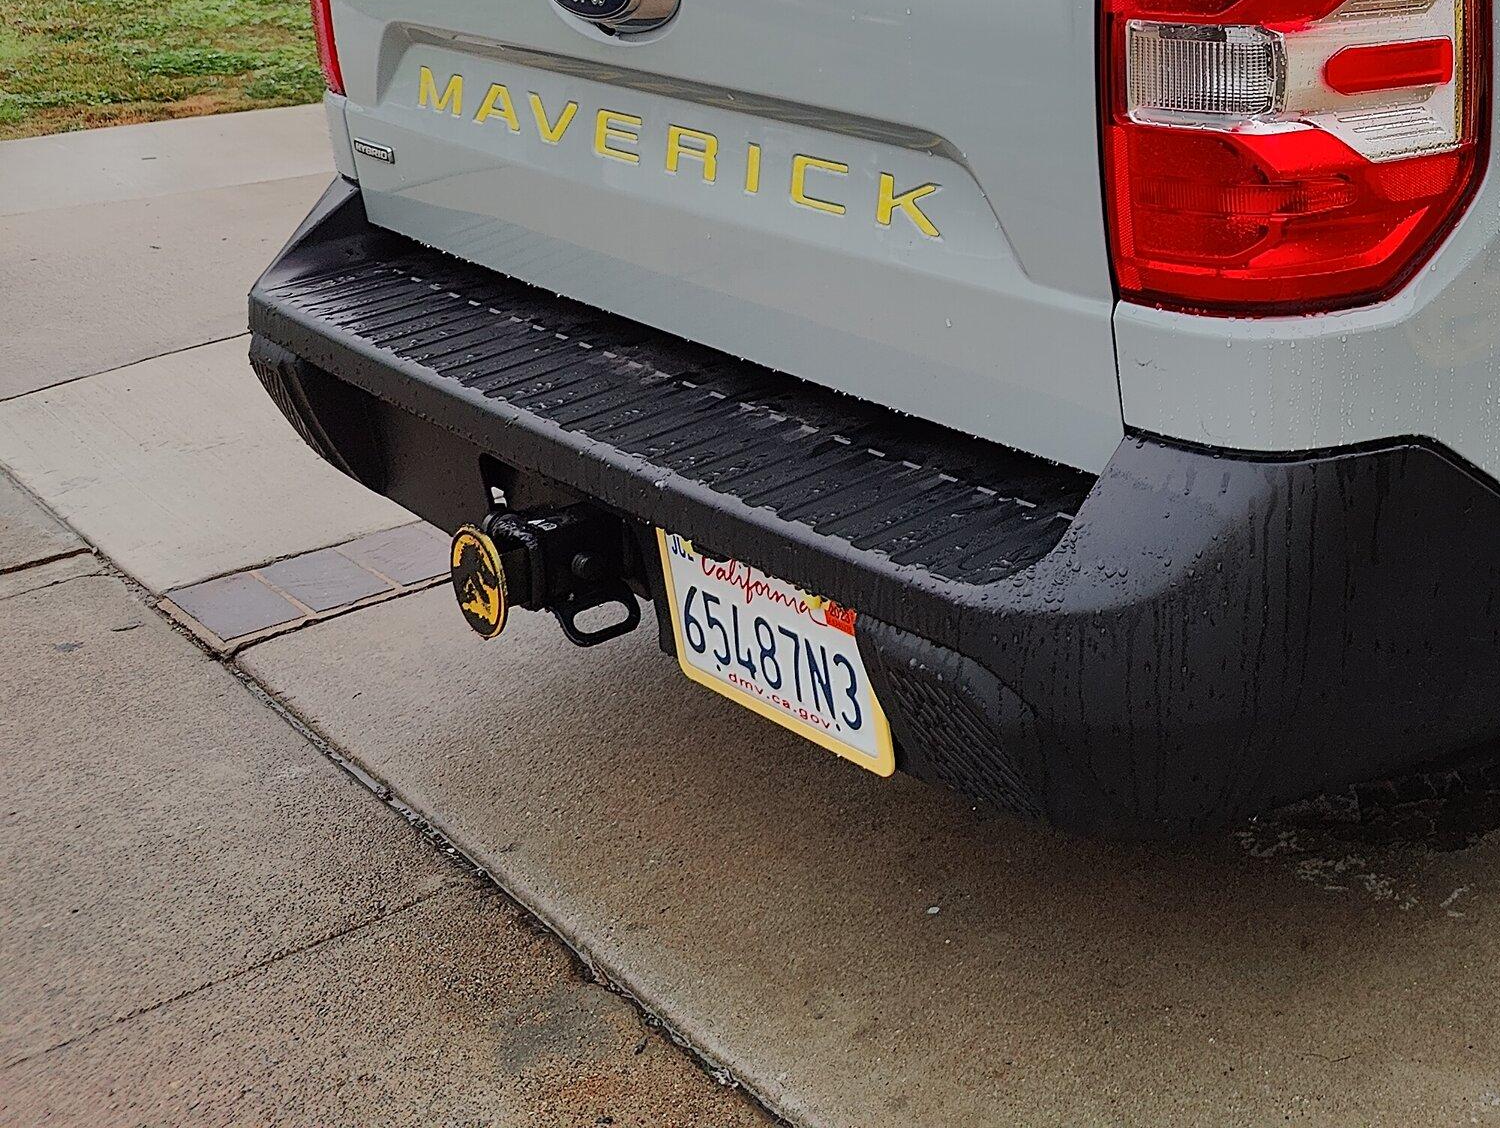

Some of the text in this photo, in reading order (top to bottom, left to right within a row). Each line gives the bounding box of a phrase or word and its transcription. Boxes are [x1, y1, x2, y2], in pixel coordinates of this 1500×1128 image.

[419, 66, 943, 239] MAVERICK
[684, 585, 863, 731] 65487N3
[729, 673, 830, 729] dmv.ca.gov
